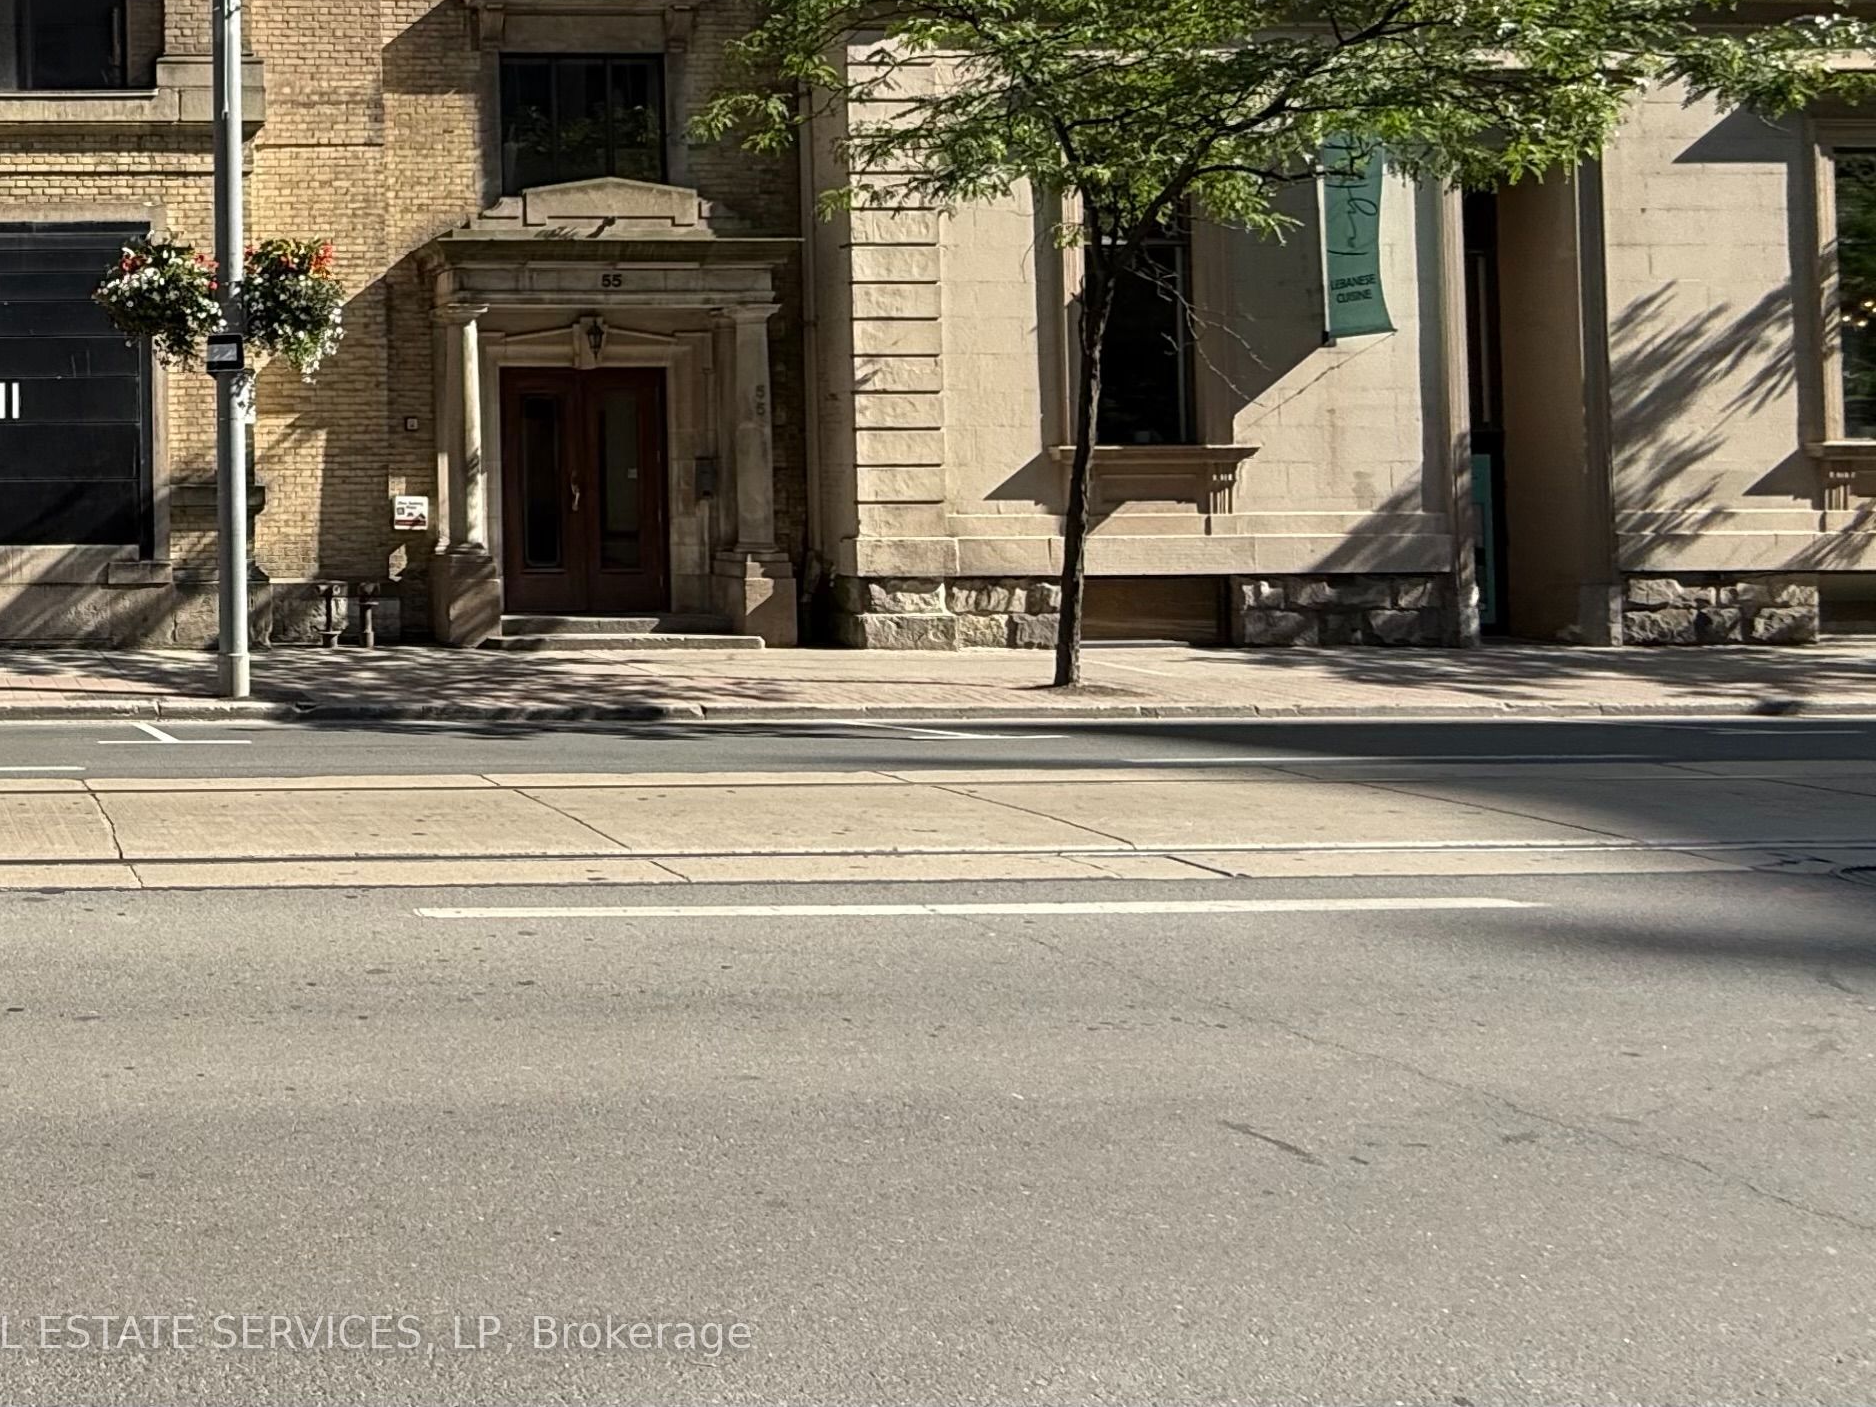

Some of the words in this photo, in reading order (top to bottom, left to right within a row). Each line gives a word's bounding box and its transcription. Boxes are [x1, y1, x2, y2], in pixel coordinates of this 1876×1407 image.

[602, 274, 622, 287] 55
[1330, 273, 1376, 290] LEBANESE
[1335, 289, 1372, 304] CUISINE
